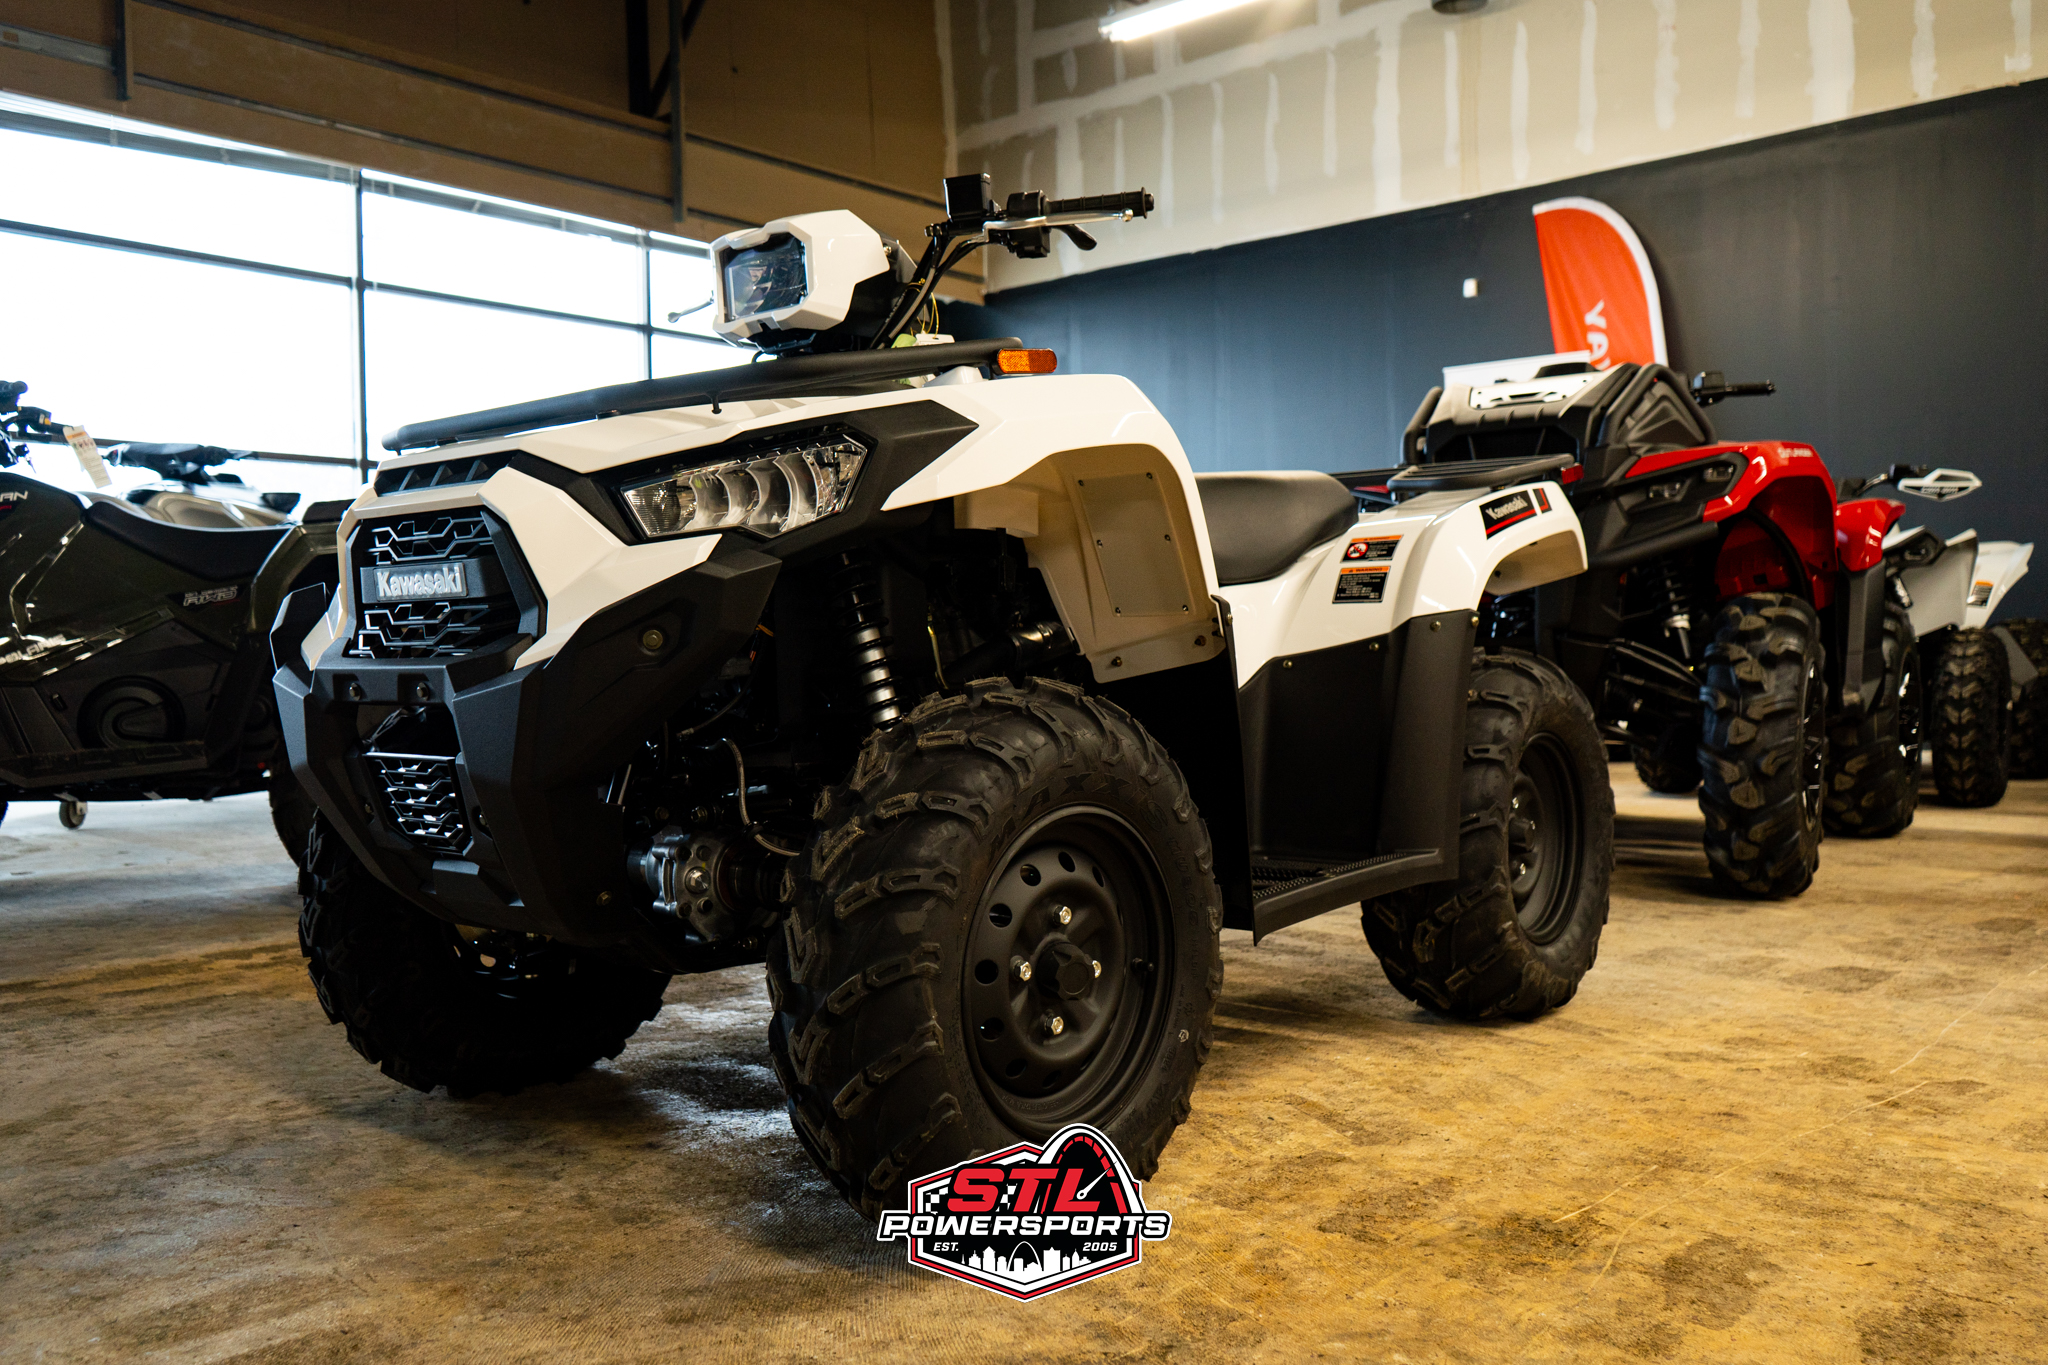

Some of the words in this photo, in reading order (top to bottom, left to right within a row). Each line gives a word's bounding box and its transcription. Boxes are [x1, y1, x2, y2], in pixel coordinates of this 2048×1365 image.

[1584, 299, 1611, 370] YA
[1485, 495, 1528, 520] Kawasaki
[377, 563, 462, 597] Kawasaki
